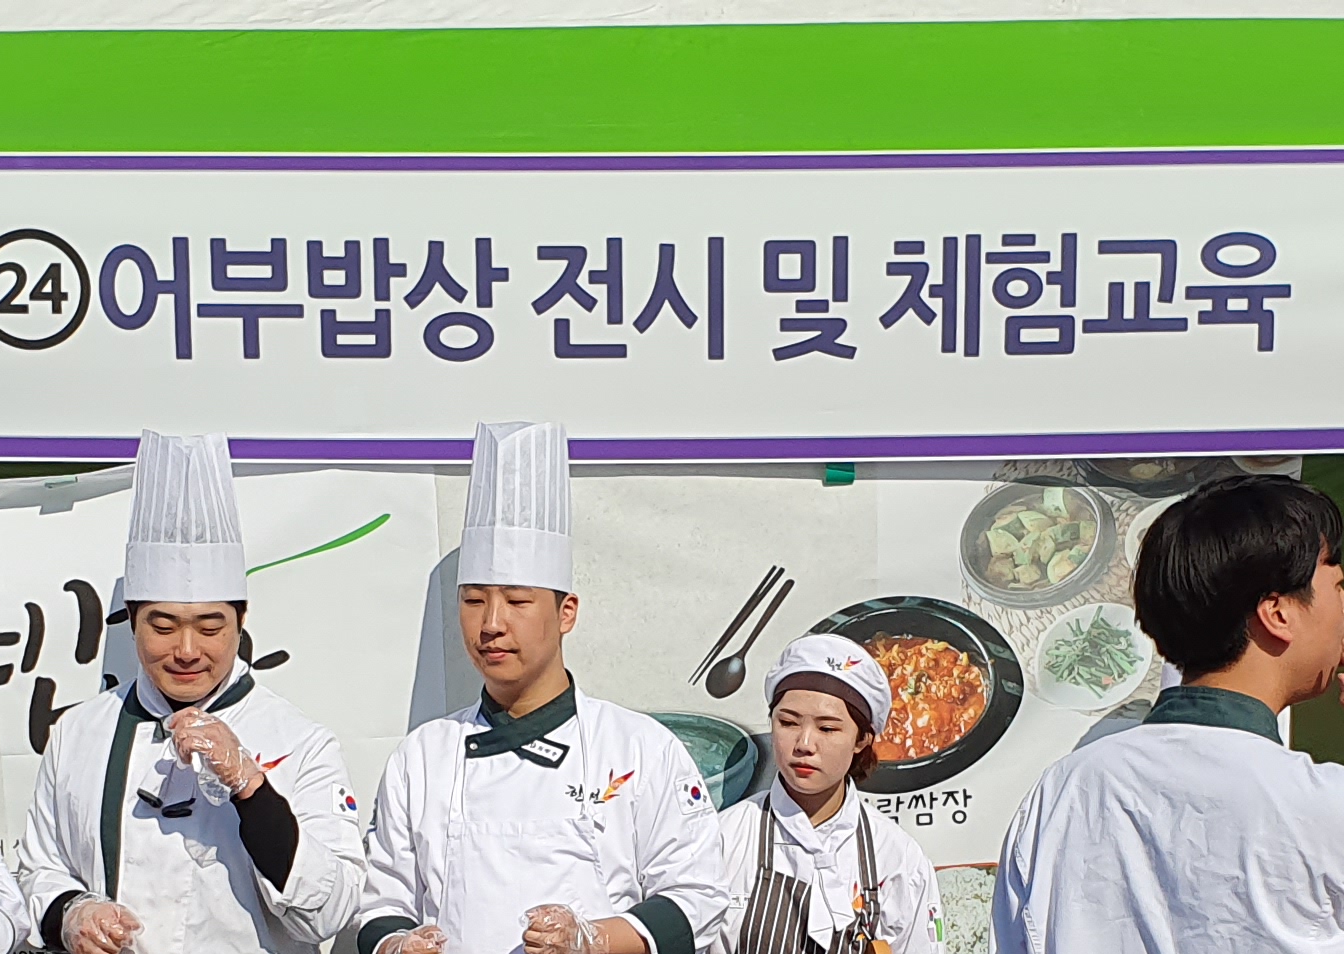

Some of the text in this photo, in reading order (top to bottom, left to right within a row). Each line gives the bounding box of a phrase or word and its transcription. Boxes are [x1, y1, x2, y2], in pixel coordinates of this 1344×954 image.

[98, 235, 509, 363] 어부밥상
[531, 236, 725, 360] 전시
[763, 235, 857, 361] 및
[878, 232, 1292, 358] 체험교육
[865, 788, 972, 826] 락쌈장
